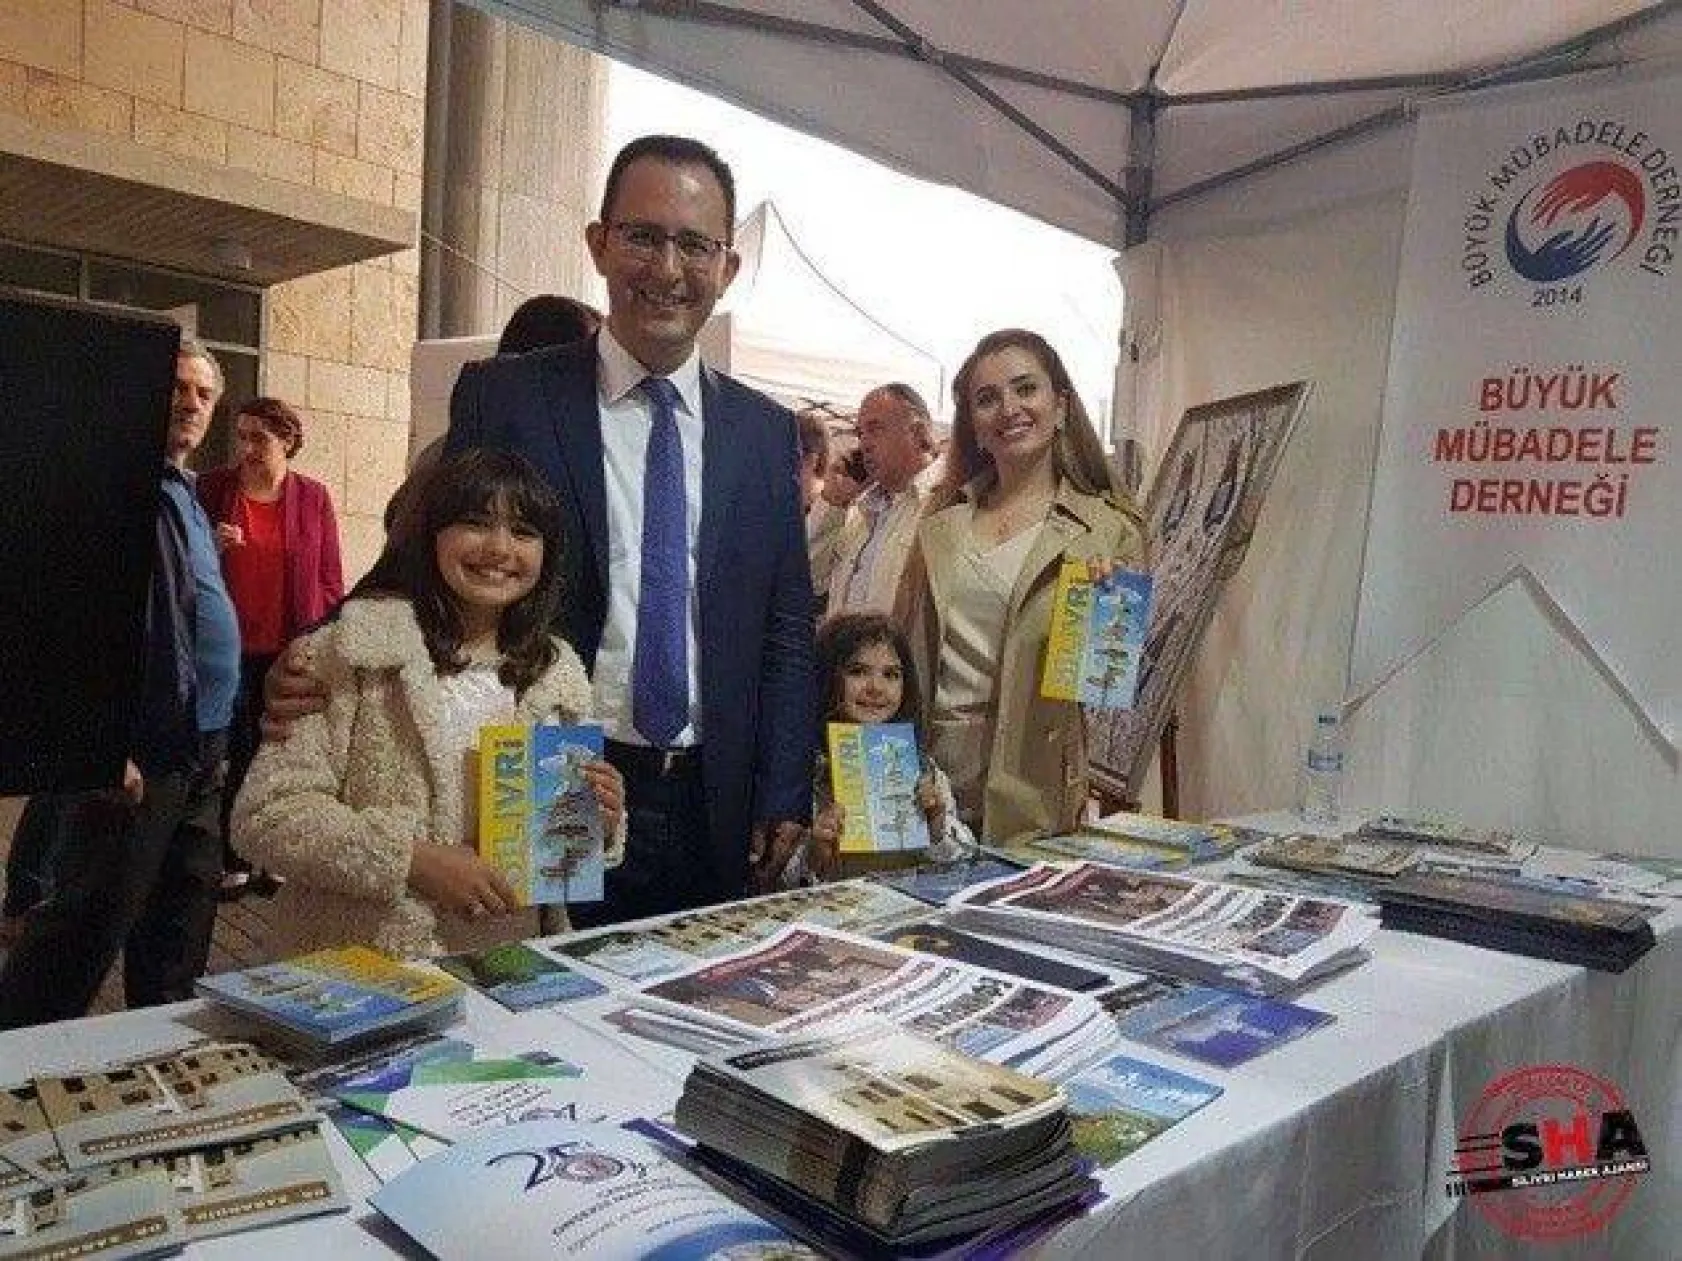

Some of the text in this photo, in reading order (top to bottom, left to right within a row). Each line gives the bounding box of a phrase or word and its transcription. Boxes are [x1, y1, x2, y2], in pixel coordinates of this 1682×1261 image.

[1531, 286, 1583, 308] 2014
[1480, 364, 1621, 412] BÜYÜK
[1434, 420, 1659, 465] MÜBADELE
[1450, 472, 1630, 518] DERNEĞİ
